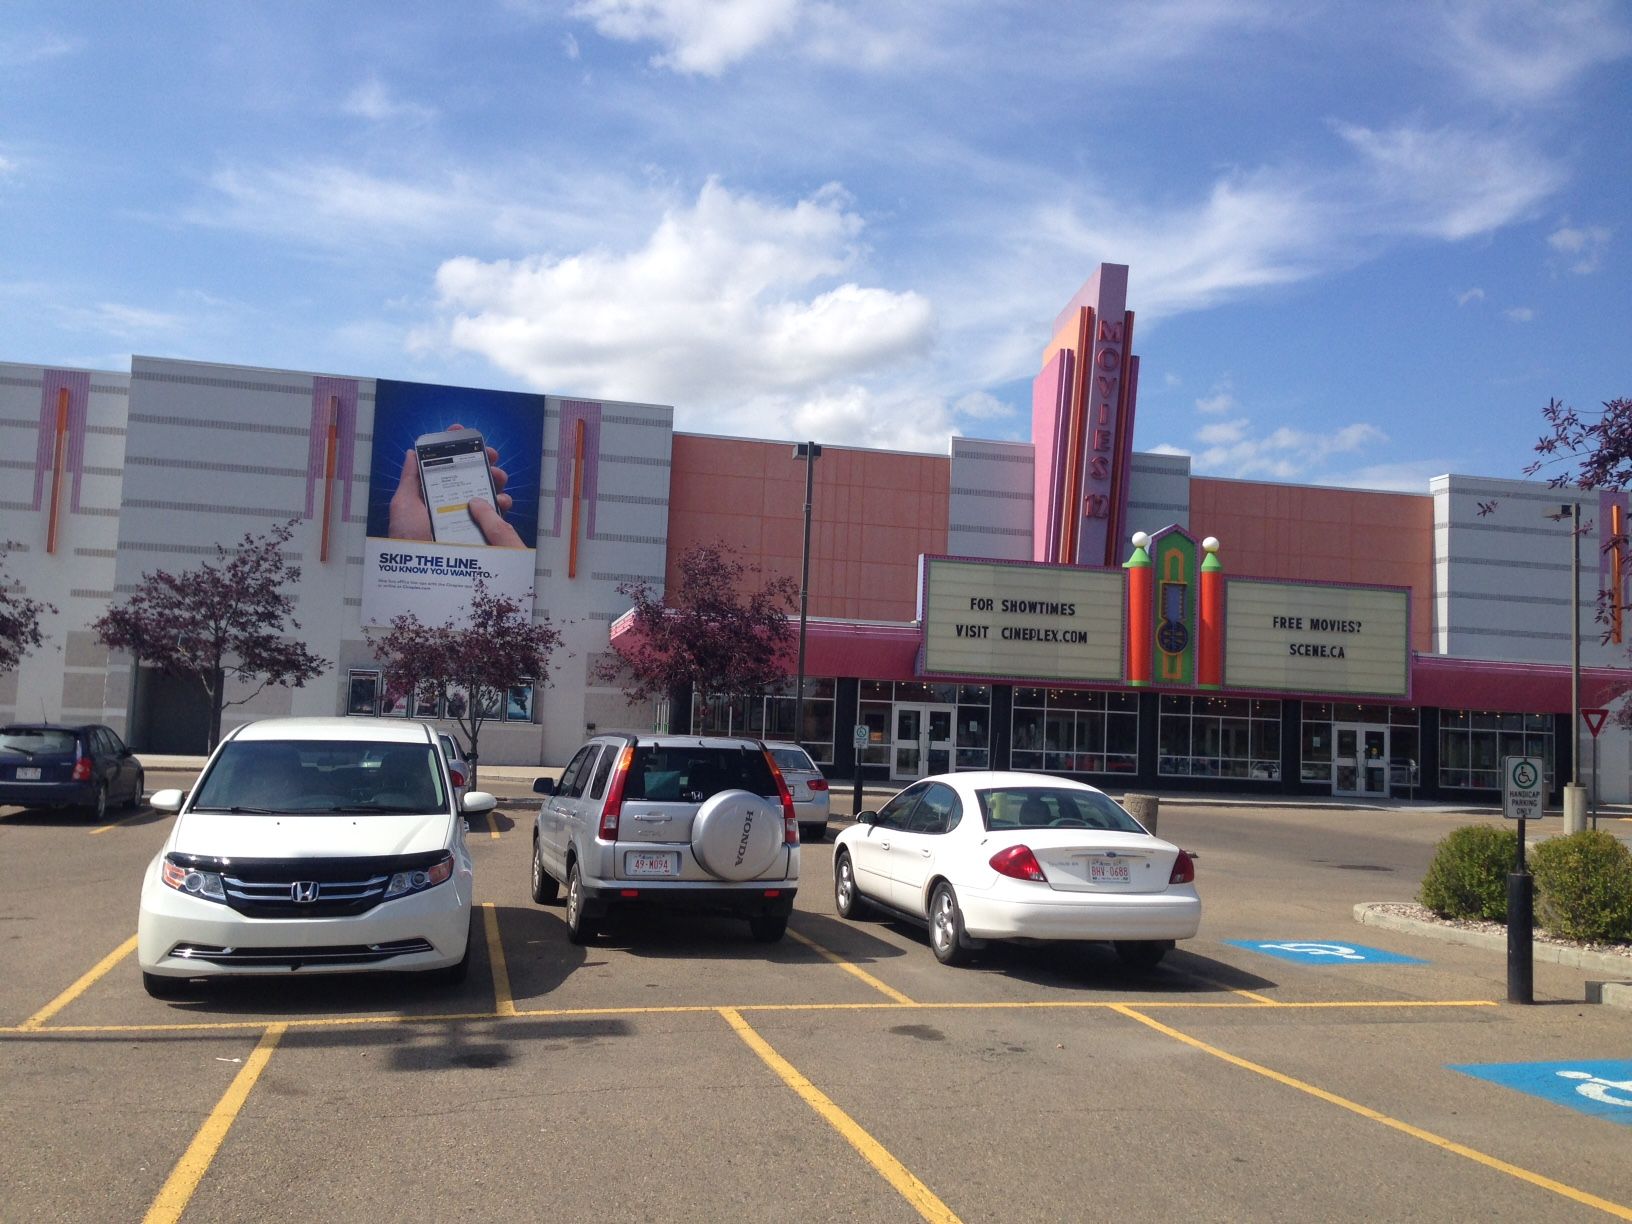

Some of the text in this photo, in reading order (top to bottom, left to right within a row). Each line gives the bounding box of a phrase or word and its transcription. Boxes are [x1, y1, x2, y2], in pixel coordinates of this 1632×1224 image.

[1091, 319, 1123, 480] MOVIES
[379, 553, 482, 570] SKIP THE LINE.
[379, 564, 493, 579] YOU KNOW YOU WANT TO.
[970, 598, 1075, 615] FOR SHOWTIMES
[1273, 616, 1361, 632] FREE MOVIES?
[956, 625, 1088, 644] VISIT CINEPLEX.COM
[1289, 643, 1345, 658] SCENE.CA
[1512, 799, 1537, 807] PARKING
[734, 810, 754, 867] HONDA
